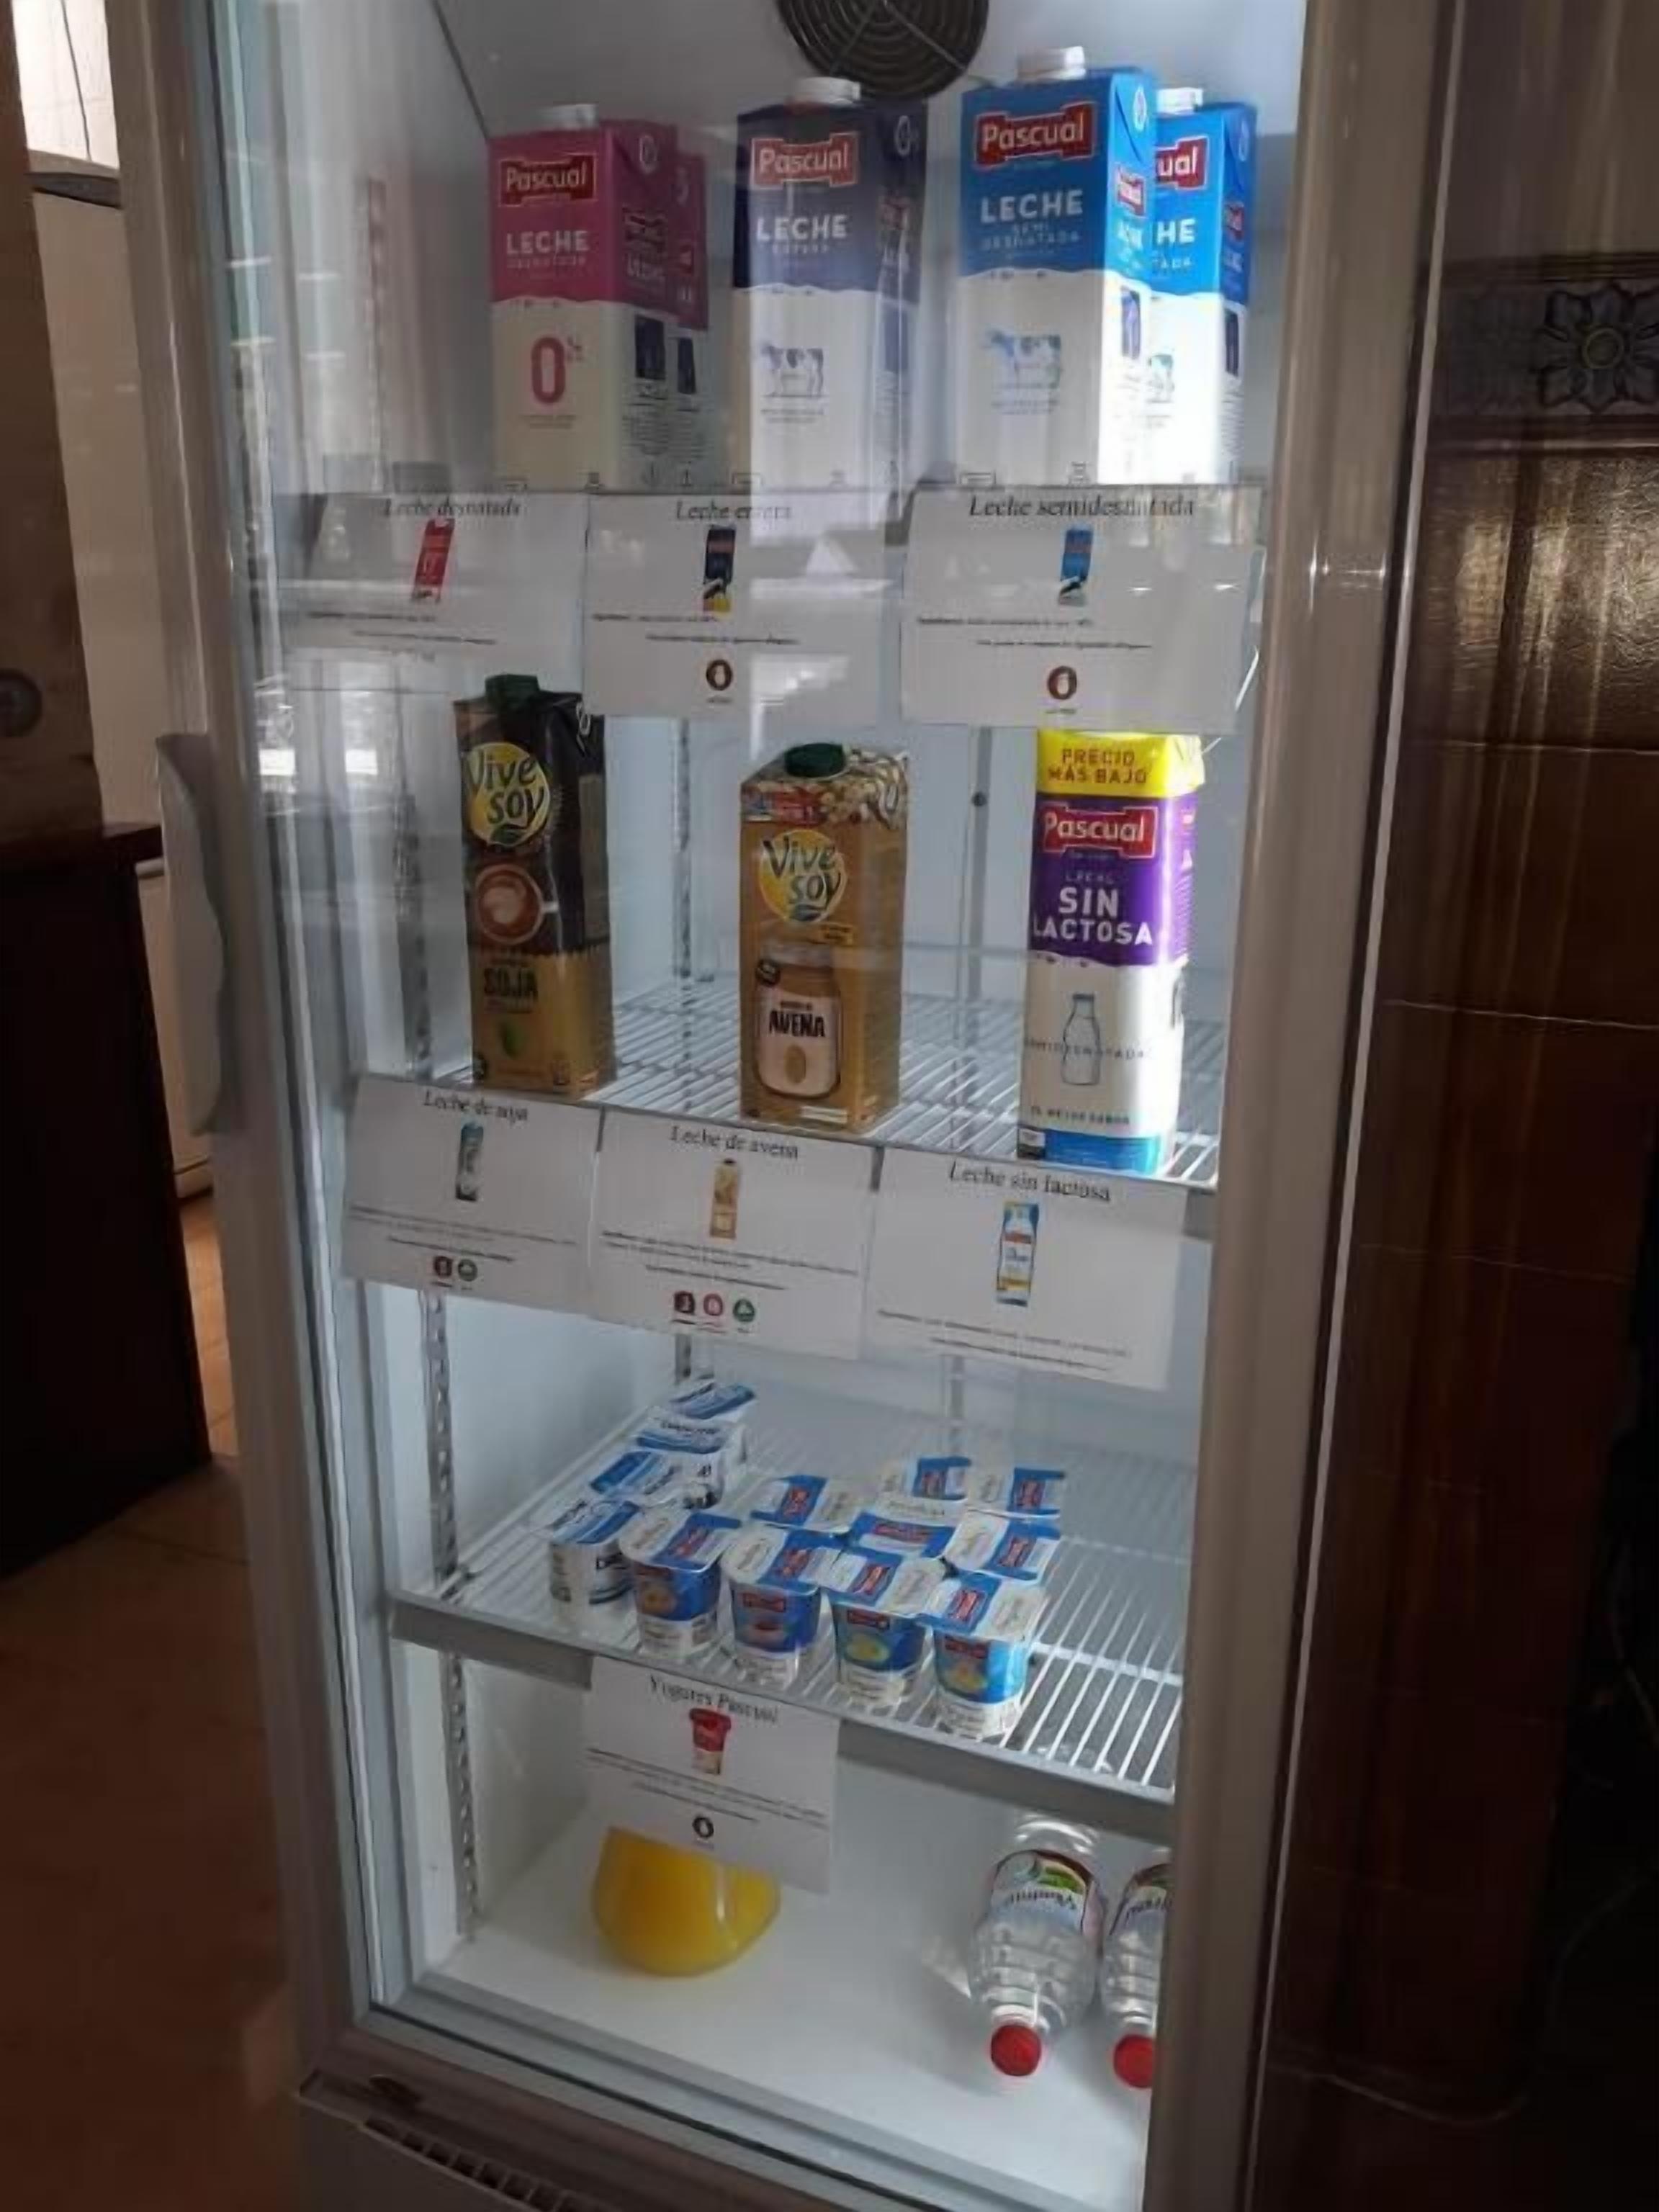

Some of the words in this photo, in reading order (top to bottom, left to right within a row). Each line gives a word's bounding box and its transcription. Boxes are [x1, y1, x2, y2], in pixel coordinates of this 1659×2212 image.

[981, 112, 1083, 152] Pascual
[760, 142, 848, 174] Pascual
[506, 161, 587, 192] Pascual
[980, 189, 1083, 223] LECHE
[506, 230, 589, 255] LECHE
[756, 215, 848, 242] LECHE
[467, 748, 539, 792] Vive
[1062, 748, 1136, 766] PRECIO
[1095, 768, 1147, 784] BAJO
[1045, 811, 1145, 842] Pascual
[763, 835, 837, 879] Vive
[1058, 886, 1119, 918] SIN
[1033, 913, 1154, 945] LACTOSA
[768, 1010, 826, 1038] AVENA
[725, 1134, 746, 1150] de
[949, 1160, 1005, 1187] Leche
[1010, 1172, 1038, 1190] sin
